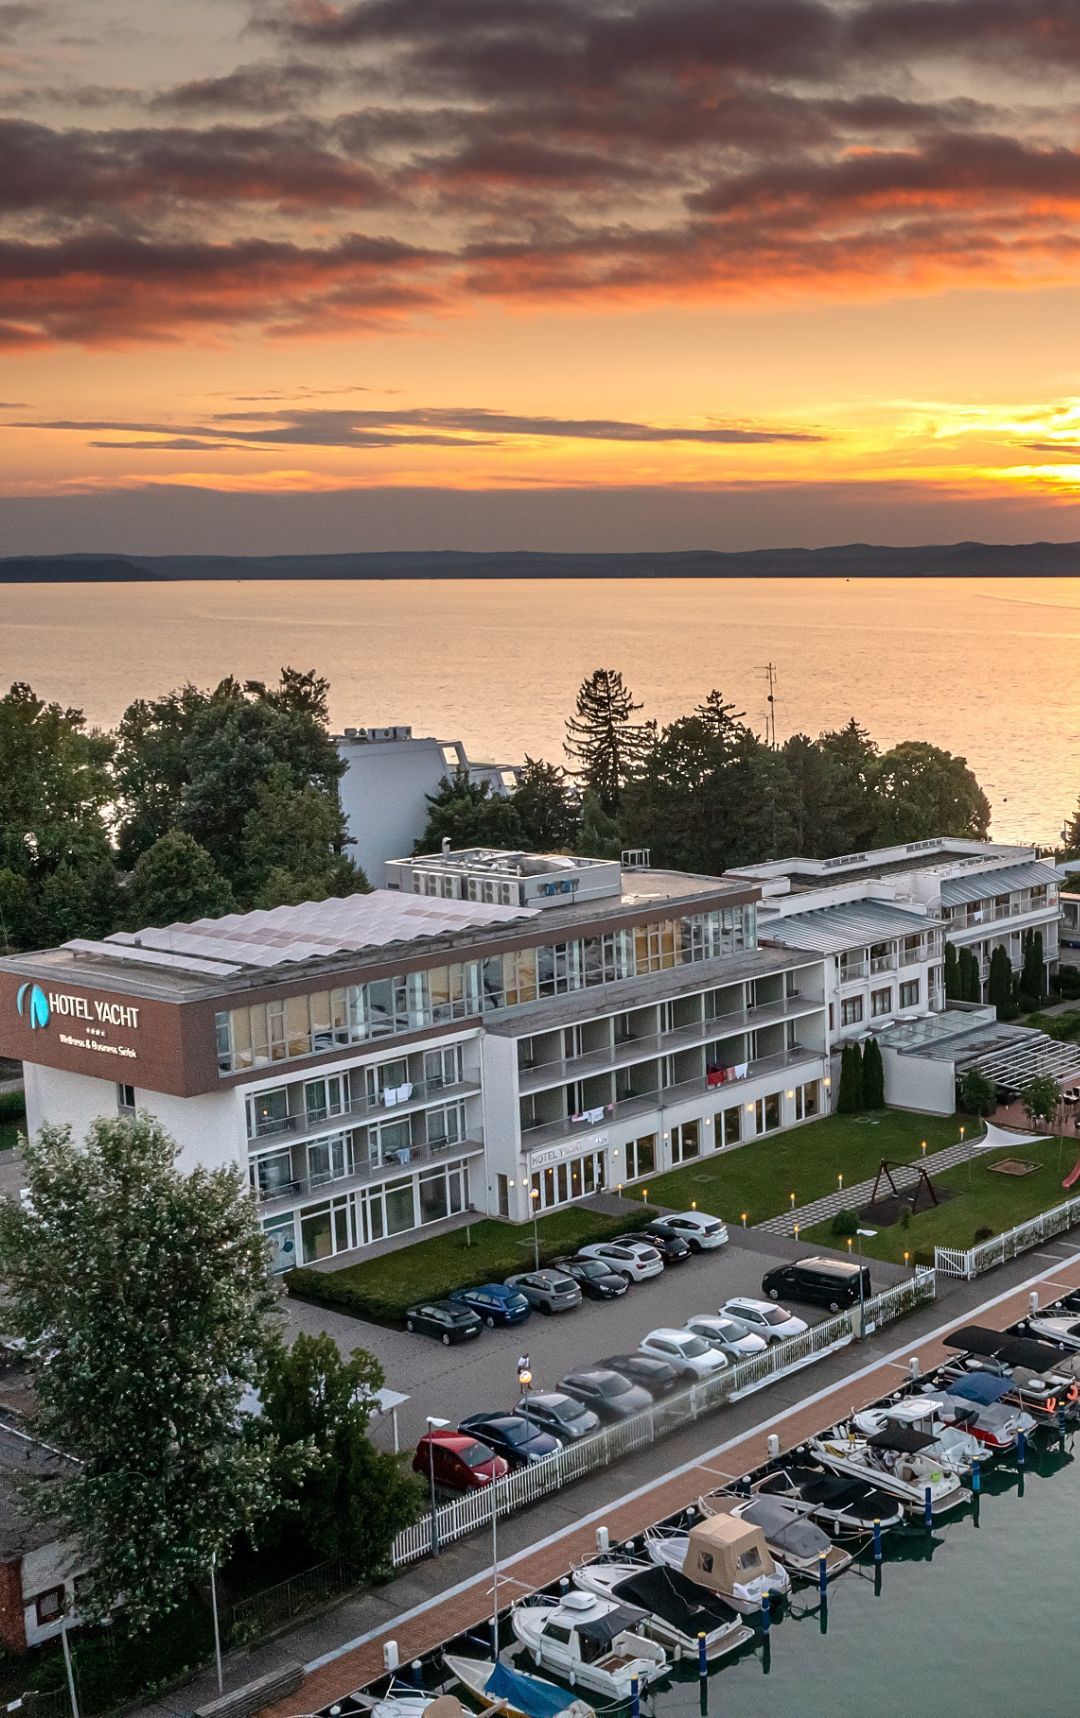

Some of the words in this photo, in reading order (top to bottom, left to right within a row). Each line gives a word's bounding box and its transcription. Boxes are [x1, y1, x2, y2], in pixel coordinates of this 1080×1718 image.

[49, 992, 94, 1020] HOTEL
[94, 1001, 140, 1028] YACHT
[91, 1041, 118, 1055] Business
[532, 1151, 558, 1166] HOTEL
